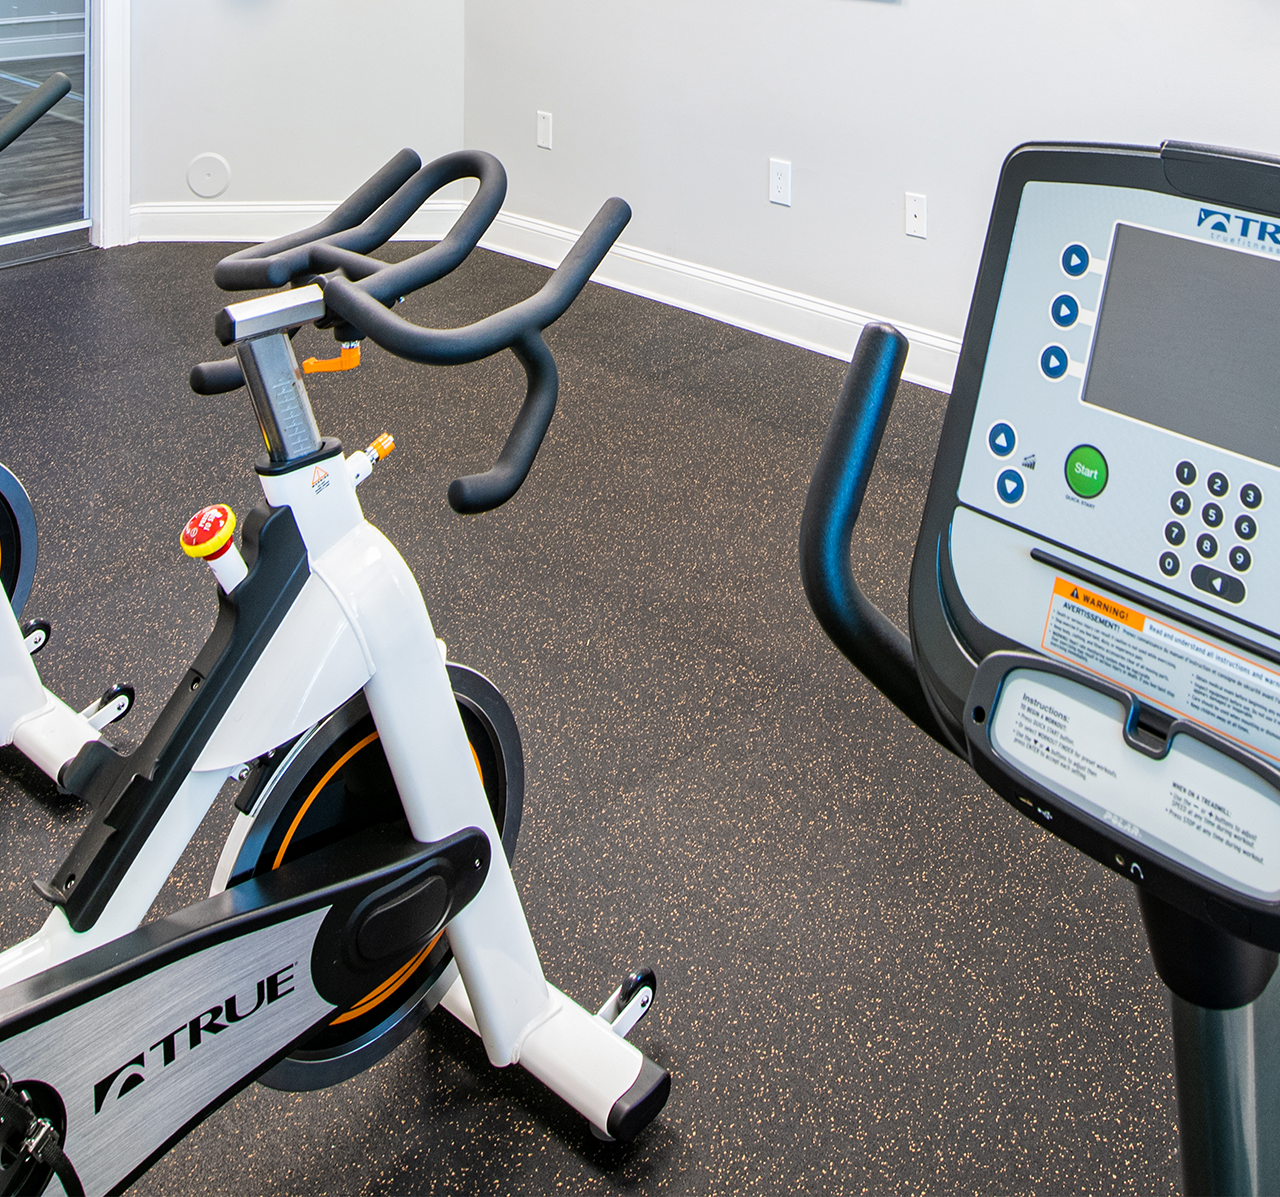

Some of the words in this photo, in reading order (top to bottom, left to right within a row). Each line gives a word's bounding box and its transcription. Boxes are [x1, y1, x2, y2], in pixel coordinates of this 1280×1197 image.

[1074, 462, 1098, 480] Start
[1184, 468, 1188, 478] 1
[1213, 478, 1222, 491] 2
[1065, 494, 1079, 504] QUICK
[1081, 500, 1095, 510] START
[1246, 490, 1254, 502] 3
[1176, 498, 1184, 509] 4
[1208, 509, 1216, 521] 5
[1172, 527, 1179, 538] 7
[1241, 522, 1249, 534] 6
[1202, 540, 1211, 552] 8
[1165, 558, 1173, 570] 0
[1236, 553, 1244, 564] 9
[1083, 594, 1128, 619] WARNING!
[1063, 602, 1120, 630] AVERTISSEMENT!
[1149, 624, 1162, 635] Read
[1163, 632, 1173, 640] and
[1174, 637, 1206, 654] understand
[1215, 655, 1250, 674] instructions
[1252, 671, 1263, 680] and
[1022, 693, 1068, 722] Instructions:
[1027, 706, 1039, 716] BEGIN
[1172, 782, 1186, 792] WHEN
[149, 962, 294, 1067] TRUE
